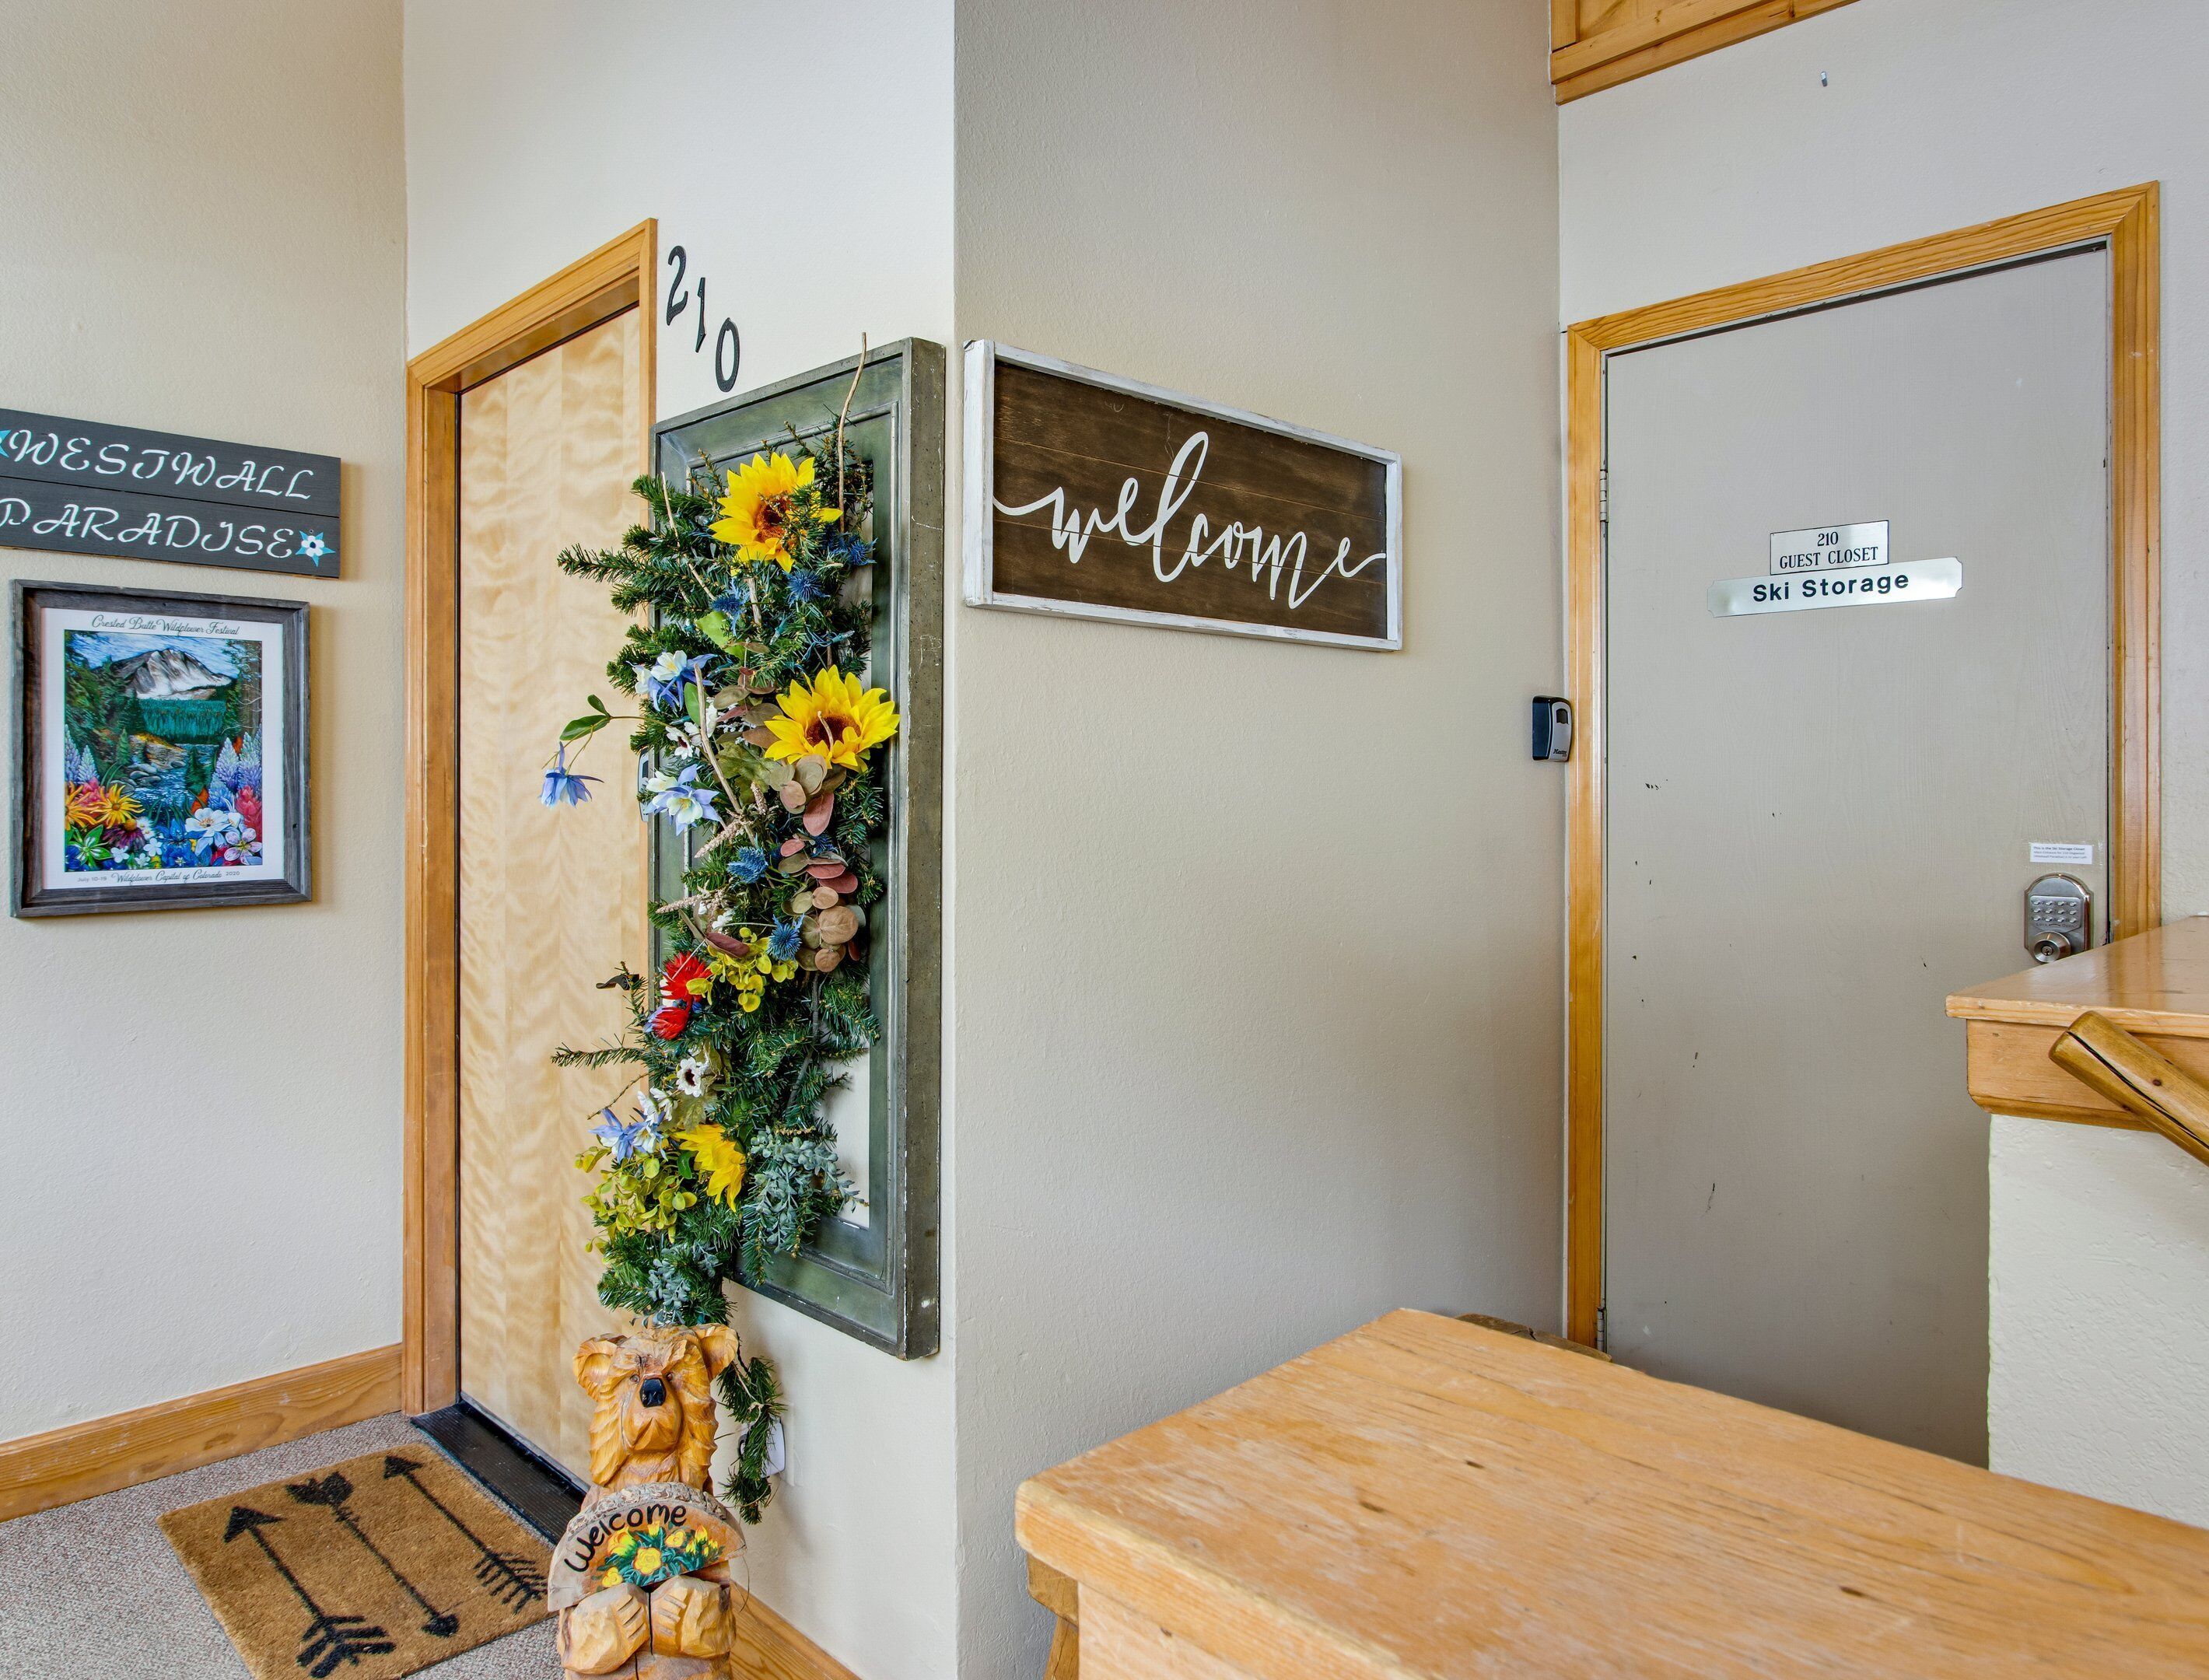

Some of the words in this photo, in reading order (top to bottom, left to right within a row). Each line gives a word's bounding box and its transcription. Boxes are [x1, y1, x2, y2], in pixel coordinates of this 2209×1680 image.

[667, 245, 740, 393] 210
[9, 429, 314, 499] WESTWALL
[0, 498, 294, 558] PARADISE
[992, 431, 1387, 610] welcome
[1817, 531, 1839, 547] 210
[1780, 552, 1821, 569] GUEST
[1828, 546, 1878, 565] CLOSET
[1752, 582, 1790, 603] Ski
[1802, 574, 1909, 598] Storage
[92, 614, 125, 629] Crested
[128, 616, 156, 630] Butte
[156, 618, 205, 637] Wildflower
[205, 621, 240, 635] Festival
[156, 870, 180, 884] Capital
[192, 869, 222, 880] Colorado
[564, 1503, 687, 1573] Welcome
